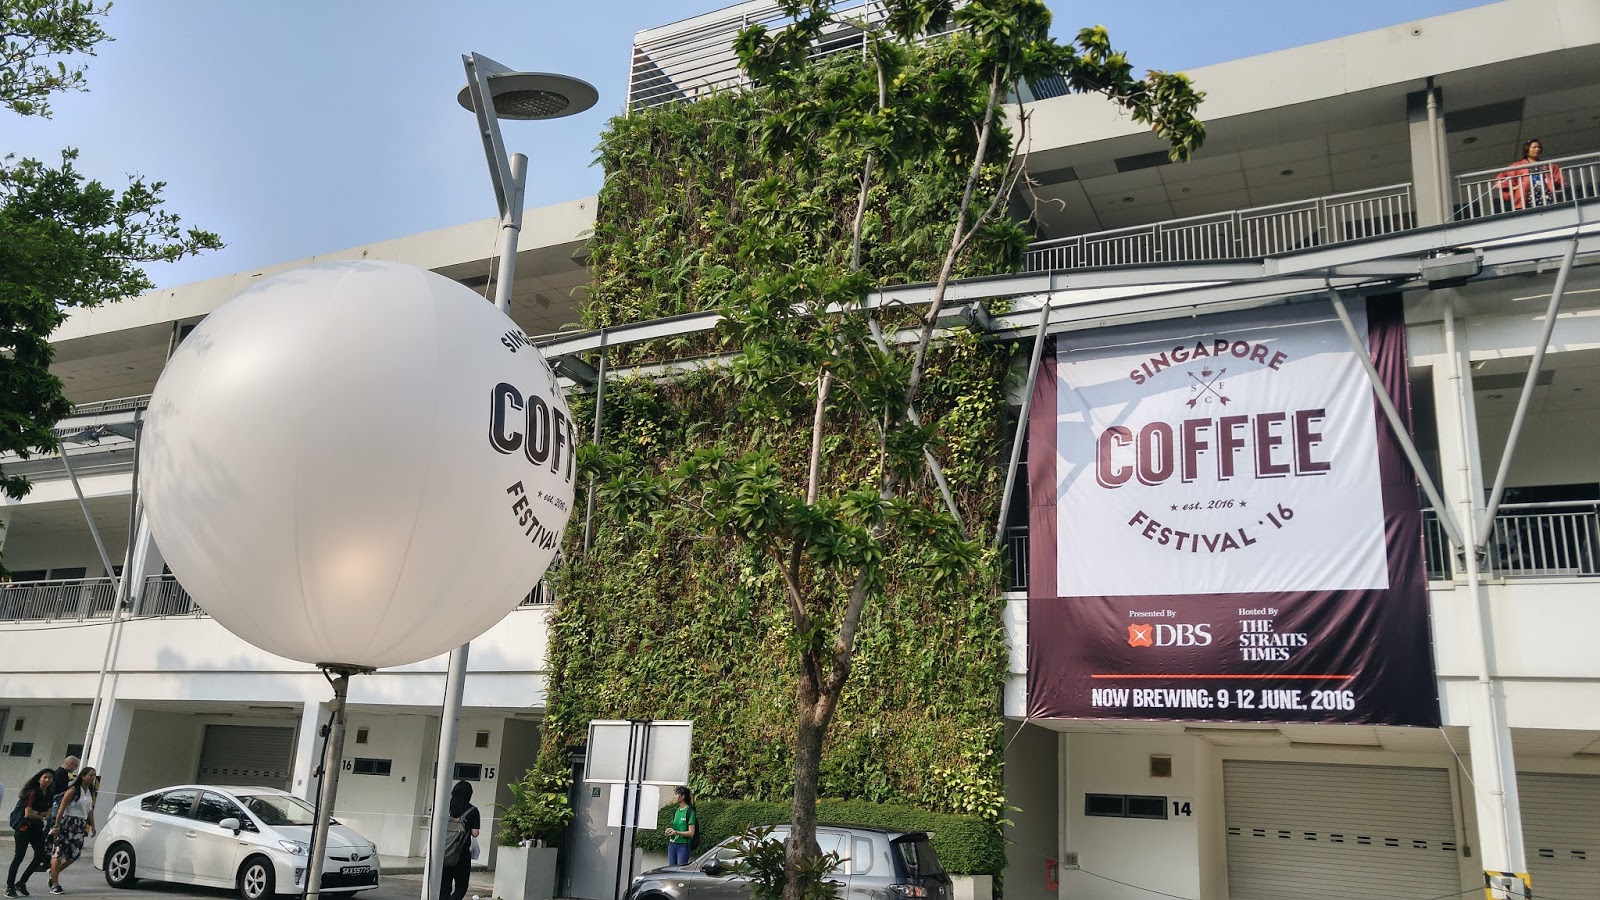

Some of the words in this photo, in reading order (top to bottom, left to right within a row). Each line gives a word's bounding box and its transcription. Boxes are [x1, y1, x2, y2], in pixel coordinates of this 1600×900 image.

[1129, 339, 1288, 385] SINGAPORE
[1190, 384, 1197, 392] S
[1219, 381, 1226, 390] F
[1204, 395, 1213, 404] C
[1095, 408, 1332, 489] COFFEE
[543, 493, 554, 504] est.
[1182, 500, 1203, 511] est.
[1207, 499, 1235, 510] 2016
[506, 480, 559, 551] FESTIVAL
[1128, 509, 1257, 553] FESTIVAL
[1129, 610, 1166, 618] Presented
[1166, 610, 1177, 618] By
[1238, 608, 1266, 616] Hosted
[1268, 607, 1279, 616] By
[1239, 619, 1274, 633] THE
[1155, 623, 1213, 647] DBS
[1239, 633, 1308, 647] STRAITS
[1239, 647, 1290, 661] TIMES
[1091, 688, 1129, 708] NOW
[1133, 688, 1214, 709] BREWING:
[1217, 689, 1255, 709] 9-12
[1258, 689, 1308, 711] JUNE,
[1311, 690, 1356, 711] 2016
[342, 759, 352, 771] 16
[484, 767, 496, 779] 15
[1172, 801, 1192, 817] 14
